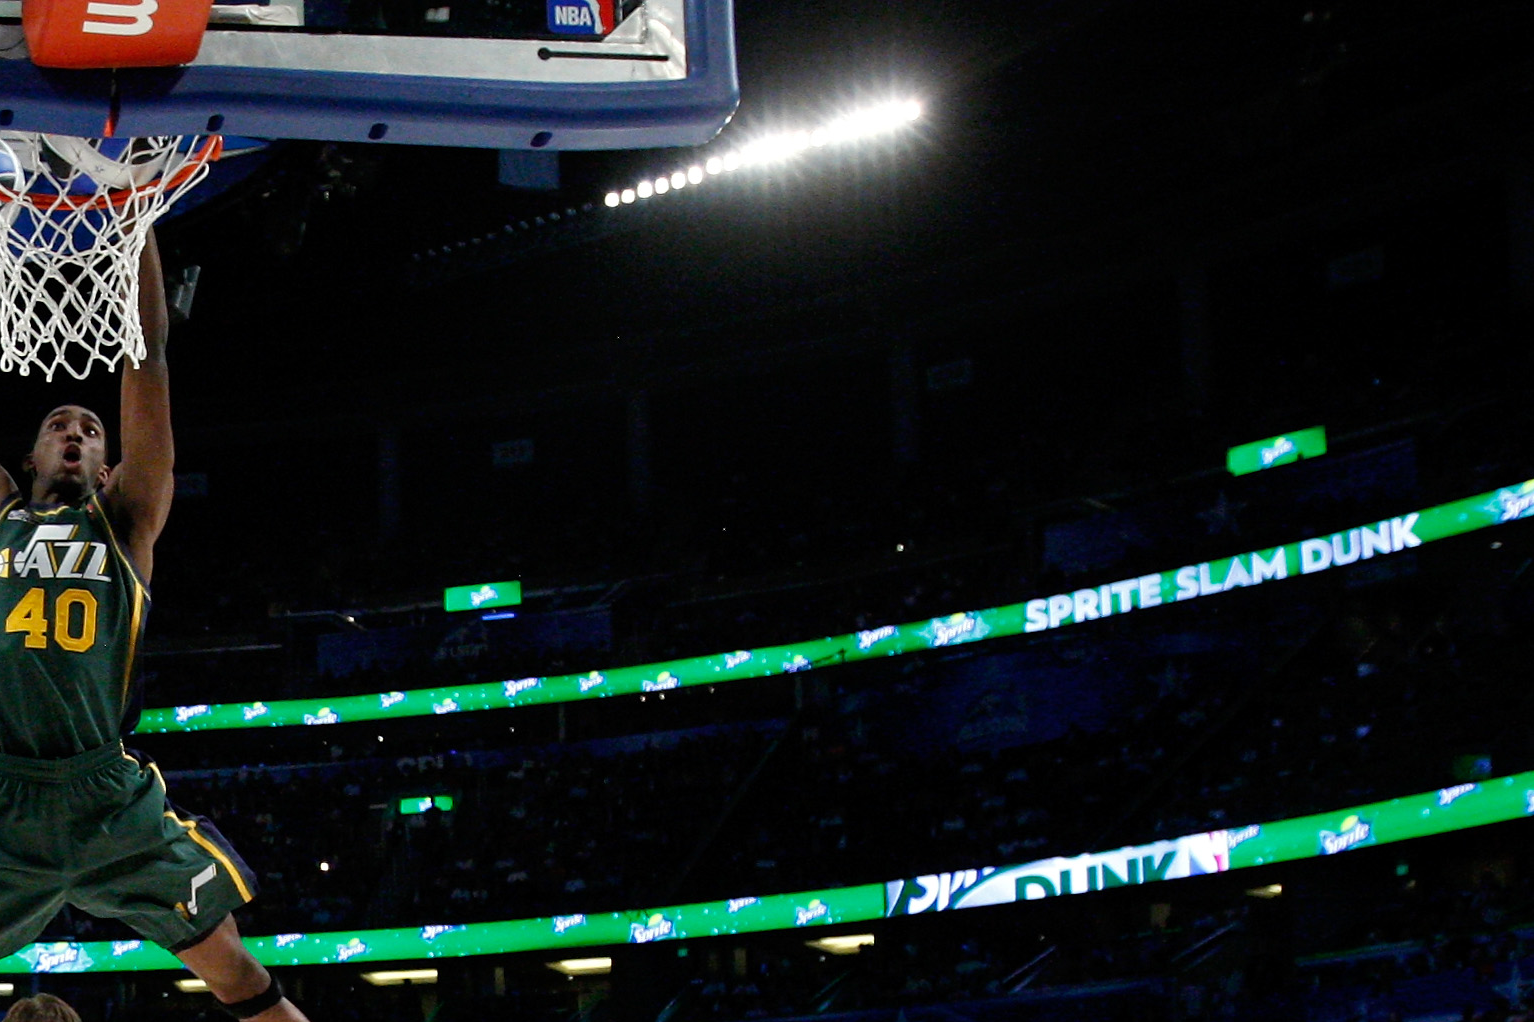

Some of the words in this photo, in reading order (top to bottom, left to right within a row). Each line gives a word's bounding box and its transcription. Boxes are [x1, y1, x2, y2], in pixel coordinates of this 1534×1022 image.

[554, 5, 593, 27] NBA
[1023, 572, 1163, 634] SPRITE
[1175, 546, 1288, 602] SLAM
[1299, 512, 1423, 575] DUNK
[4, 587, 98, 653] 40
